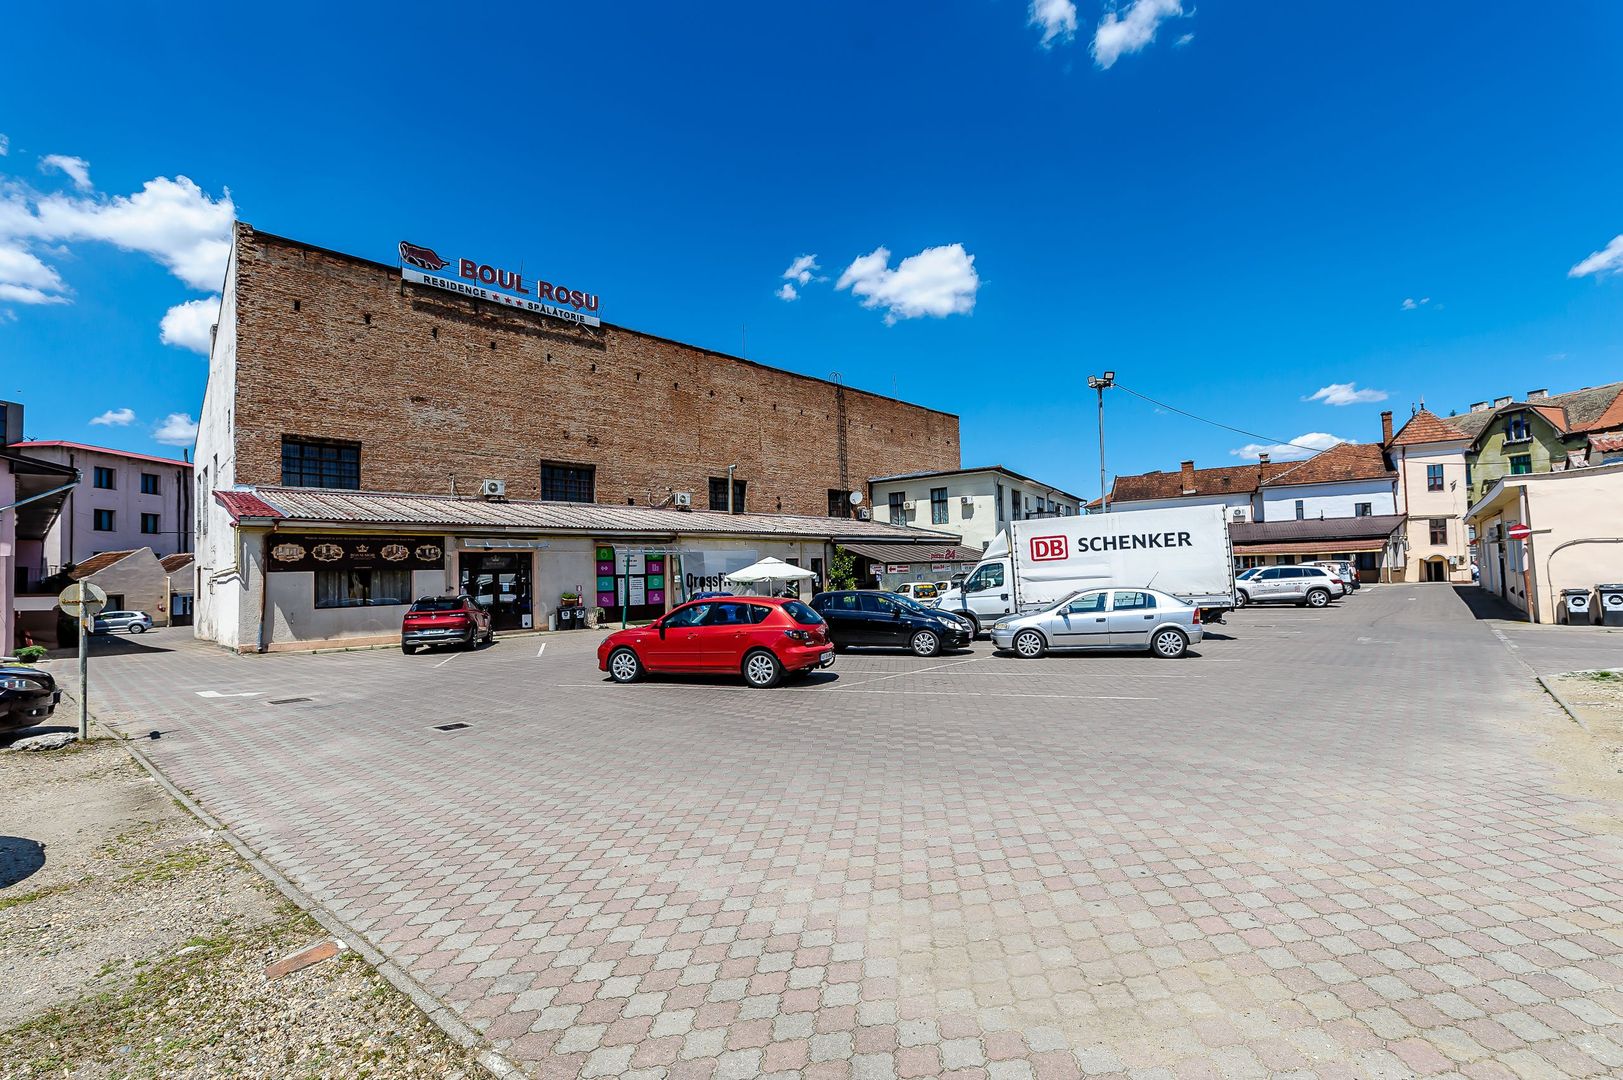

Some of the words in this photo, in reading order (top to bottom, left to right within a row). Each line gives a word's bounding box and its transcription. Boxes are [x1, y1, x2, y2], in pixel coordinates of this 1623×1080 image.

[423, 275, 487, 298] RESIDENCE
[459, 258, 529, 294] BOUL
[538, 280, 599, 313] ROȘU
[1035, 540, 1064, 558] DB
[1078, 531, 1193, 552] SCHENKER
